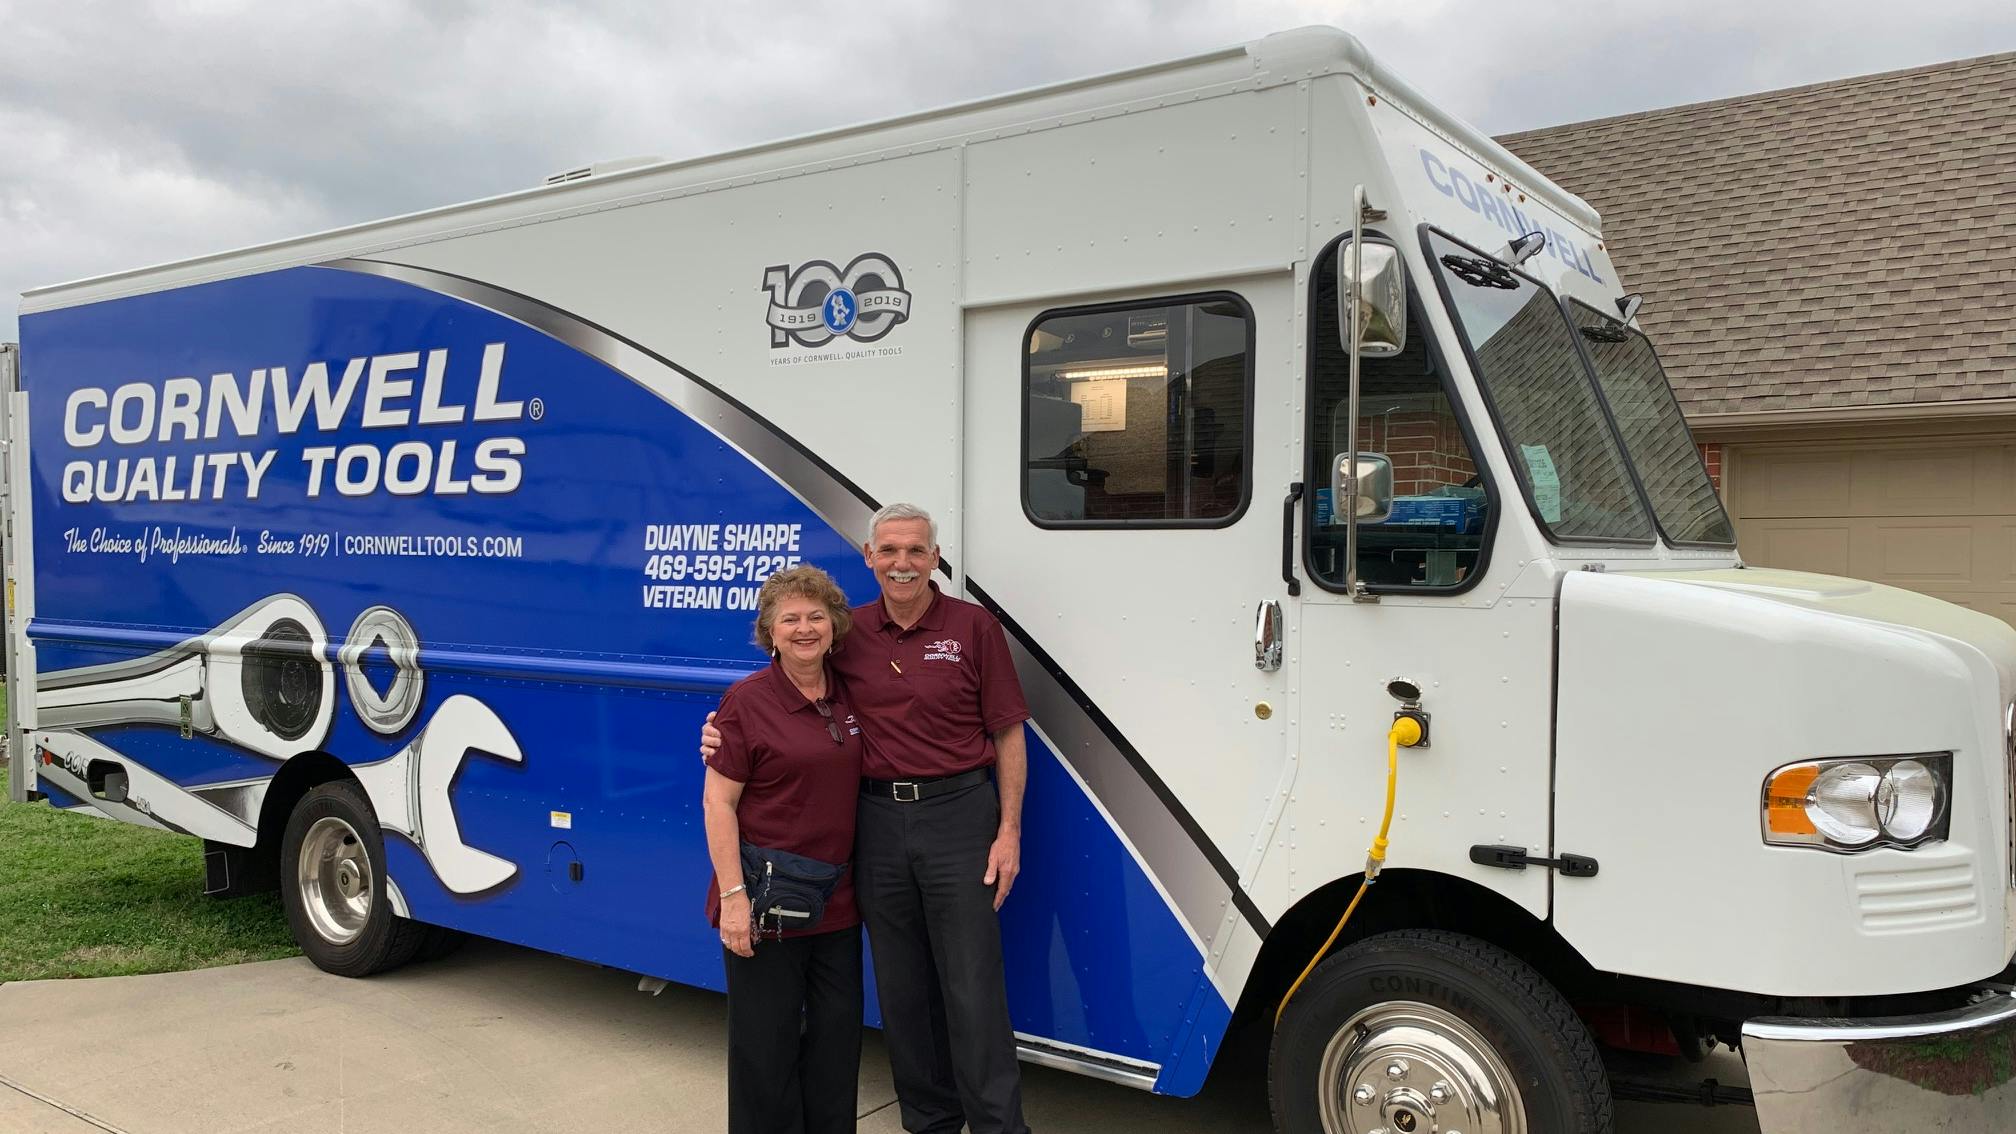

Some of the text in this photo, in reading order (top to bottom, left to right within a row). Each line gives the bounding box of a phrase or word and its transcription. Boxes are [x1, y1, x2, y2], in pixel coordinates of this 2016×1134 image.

[864, 295, 902, 307] 2019
[779, 313, 816, 324] 1919
[770, 357, 791, 366] YEARS
[793, 356, 802, 364] OF
[846, 349, 876, 360] QUALITY
[878, 346, 903, 356] TOOLS
[62, 436, 526, 504] QUALITY TOOLS
[64, 527, 87, 553] The
[90, 527, 132, 553] Choice
[134, 527, 148, 564] of
[257, 530, 295, 554] Since
[298, 534, 330, 557] 1919
[344, 535, 522, 557] CORNWELLTOOLS.COM
[645, 524, 802, 552] DUAYNE SHARPE
[643, 585, 722, 610] VETERAN
